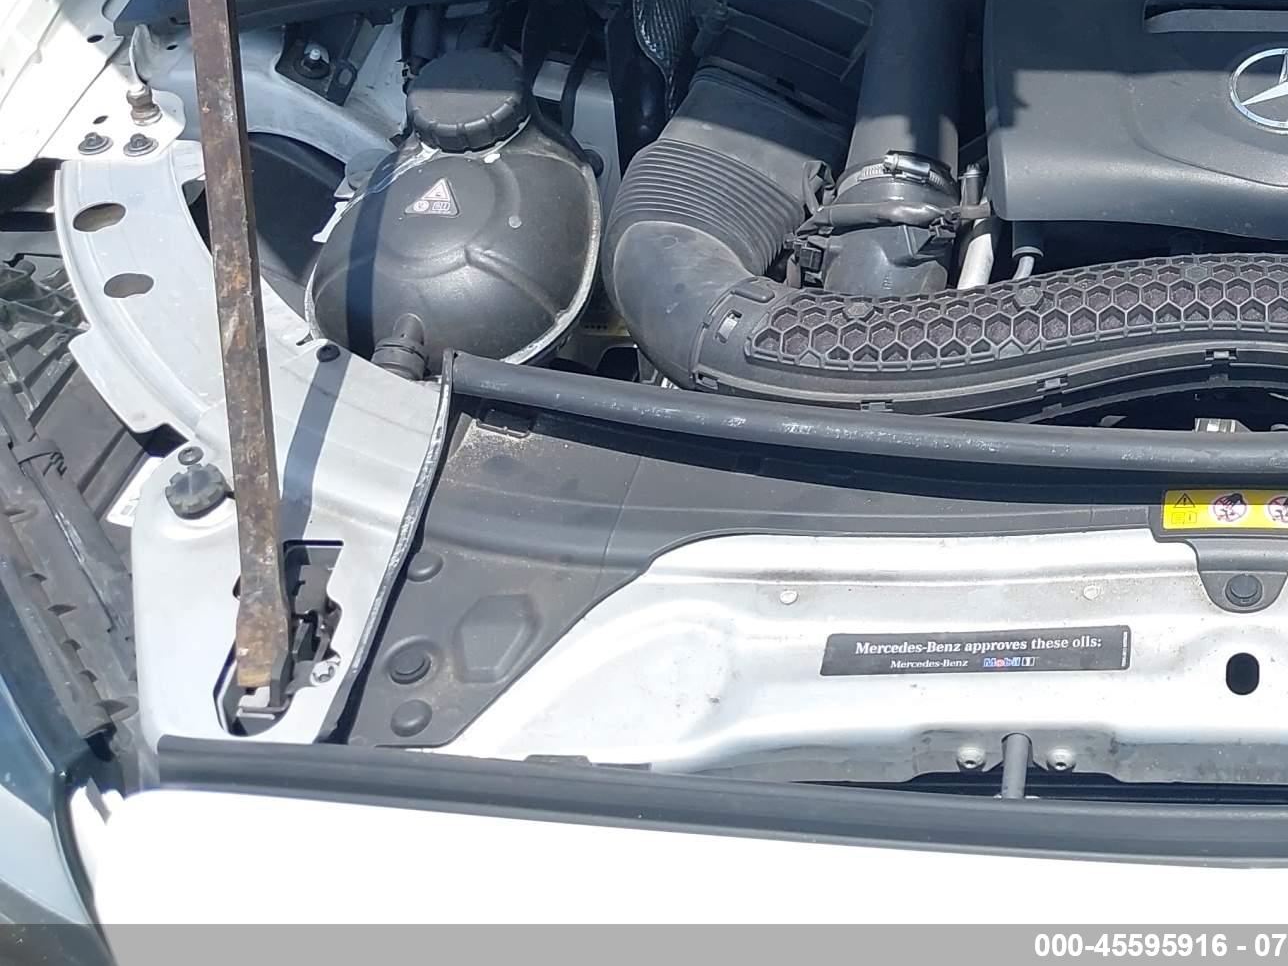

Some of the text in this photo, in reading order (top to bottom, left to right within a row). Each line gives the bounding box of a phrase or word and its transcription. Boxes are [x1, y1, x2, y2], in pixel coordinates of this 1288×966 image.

[855, 634, 1102, 654] Mercedes-Benz approves these oils:
[890, 659, 968, 669] Mercedes-Benz
[983, 657, 1021, 667] Mobil
